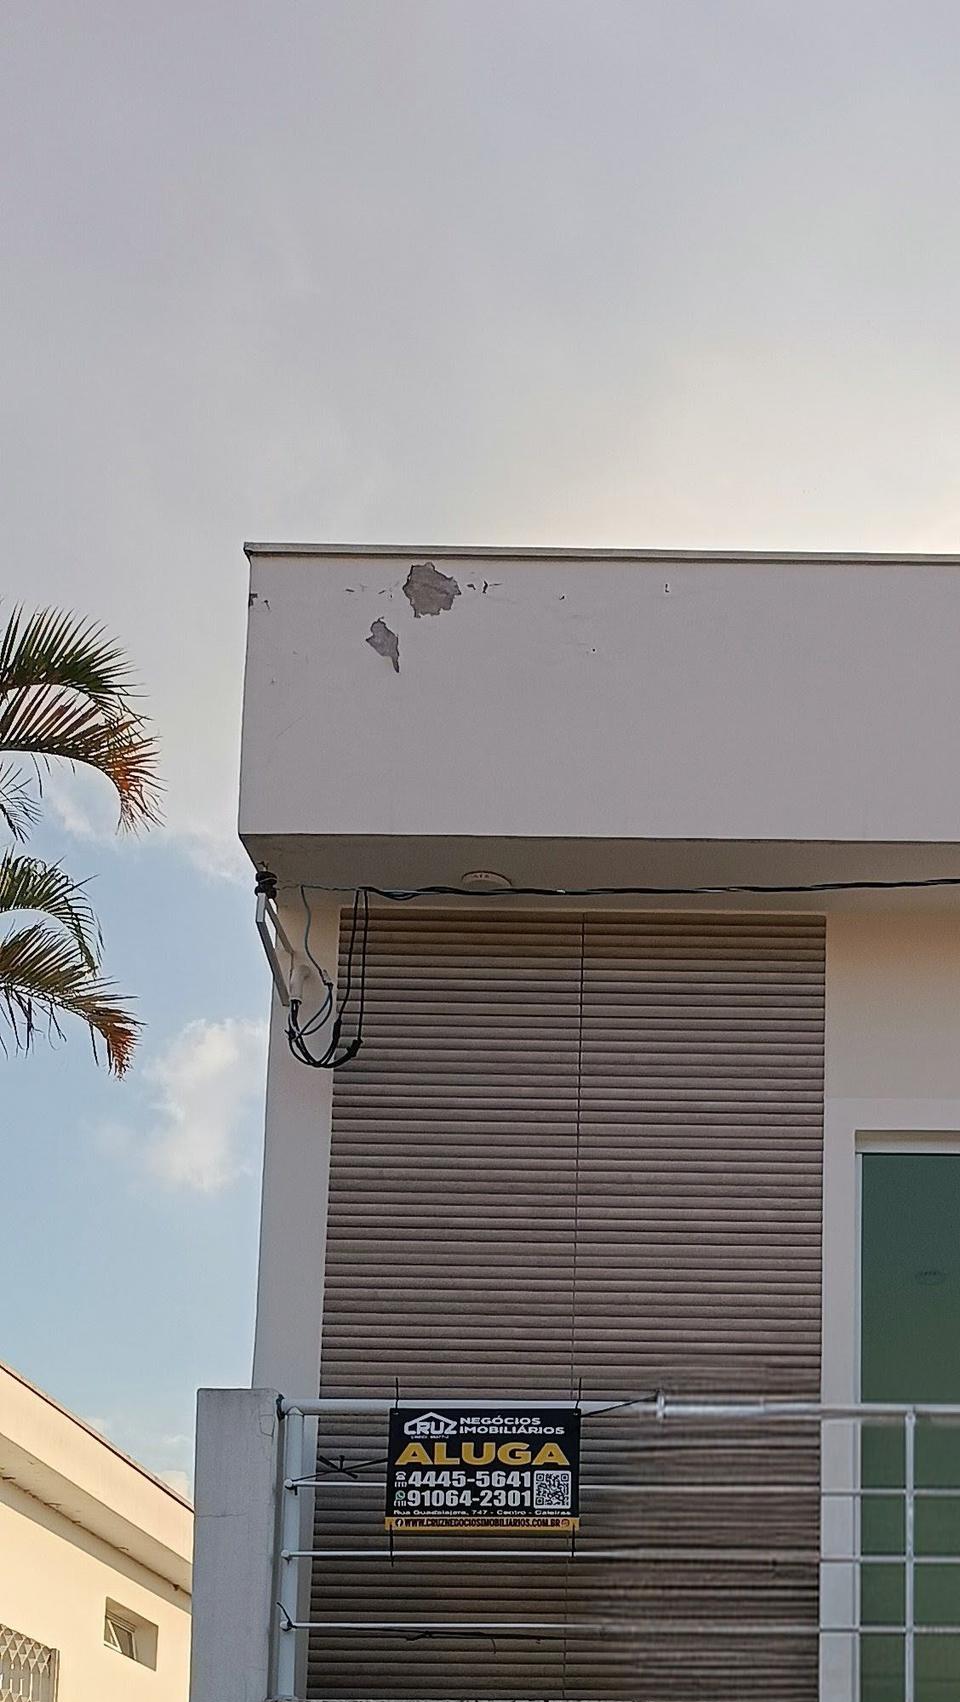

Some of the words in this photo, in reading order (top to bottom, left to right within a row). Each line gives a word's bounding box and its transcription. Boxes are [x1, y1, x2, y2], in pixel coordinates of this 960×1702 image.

[403, 1416, 458, 1435] CRUZ
[459, 1415, 541, 1425] NEGÓCIOS
[459, 1425, 565, 1435] IMOBILIÁRIOS
[394, 1442, 570, 1465] ALUGA
[408, 1471, 531, 1488] 4445-5641
[407, 1490, 531, 1507] 91064-2301
